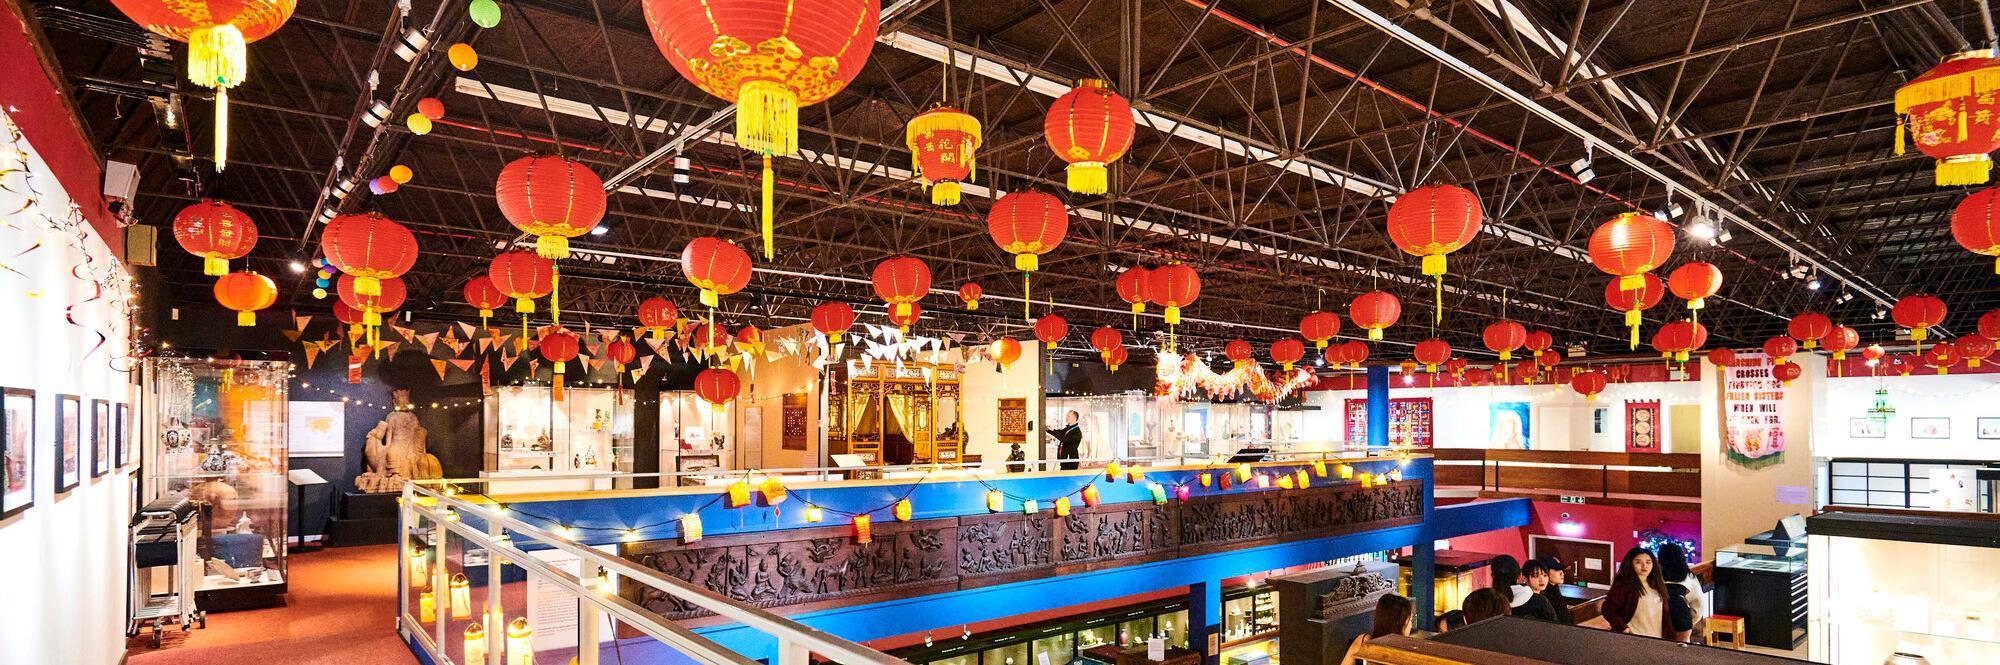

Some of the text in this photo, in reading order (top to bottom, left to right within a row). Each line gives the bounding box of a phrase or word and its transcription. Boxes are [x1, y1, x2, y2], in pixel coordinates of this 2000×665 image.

[1736, 369, 1769, 378] CROSSES
[1754, 392, 1784, 400] SISTERS
[1734, 404, 1777, 412] WHEN WILL
